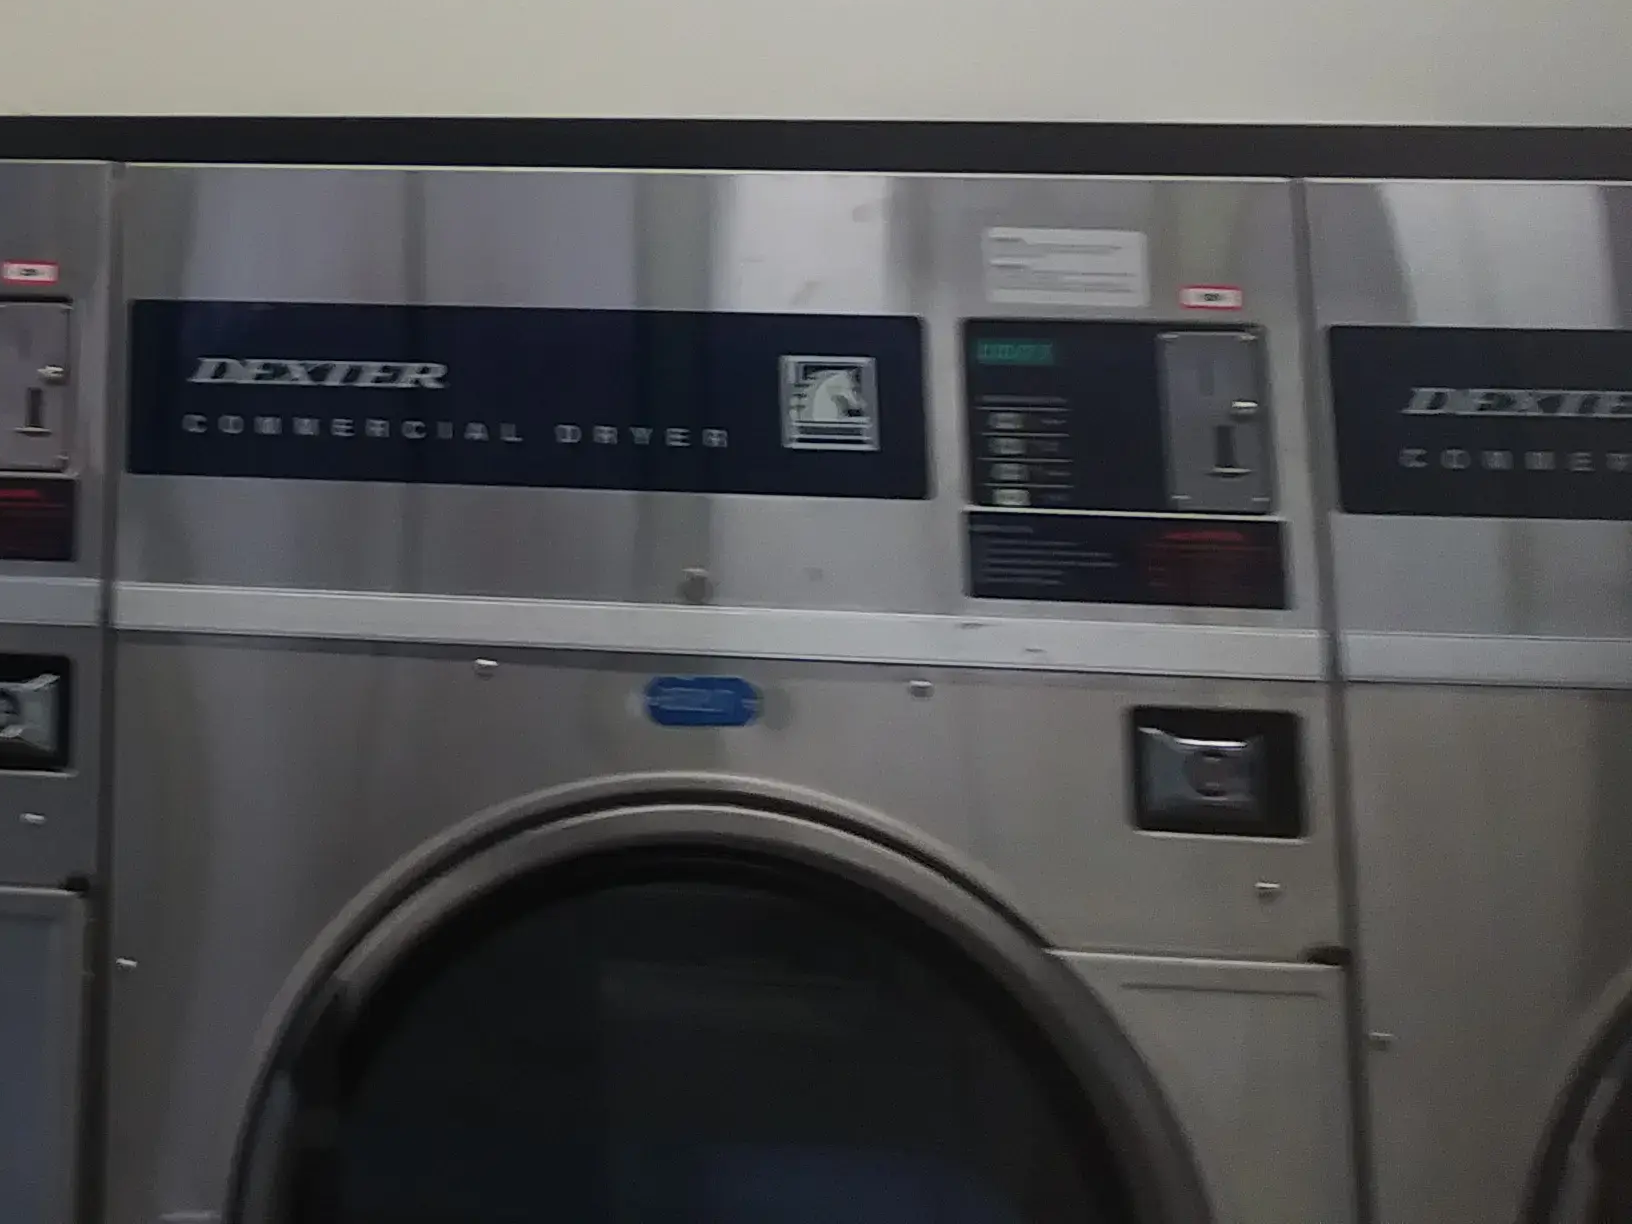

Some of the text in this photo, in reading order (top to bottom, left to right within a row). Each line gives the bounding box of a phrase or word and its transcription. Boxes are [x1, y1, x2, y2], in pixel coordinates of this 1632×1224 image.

[186, 356, 449, 390] DEXTER
[181, 413, 729, 448] COMMERCIAL DRYER
